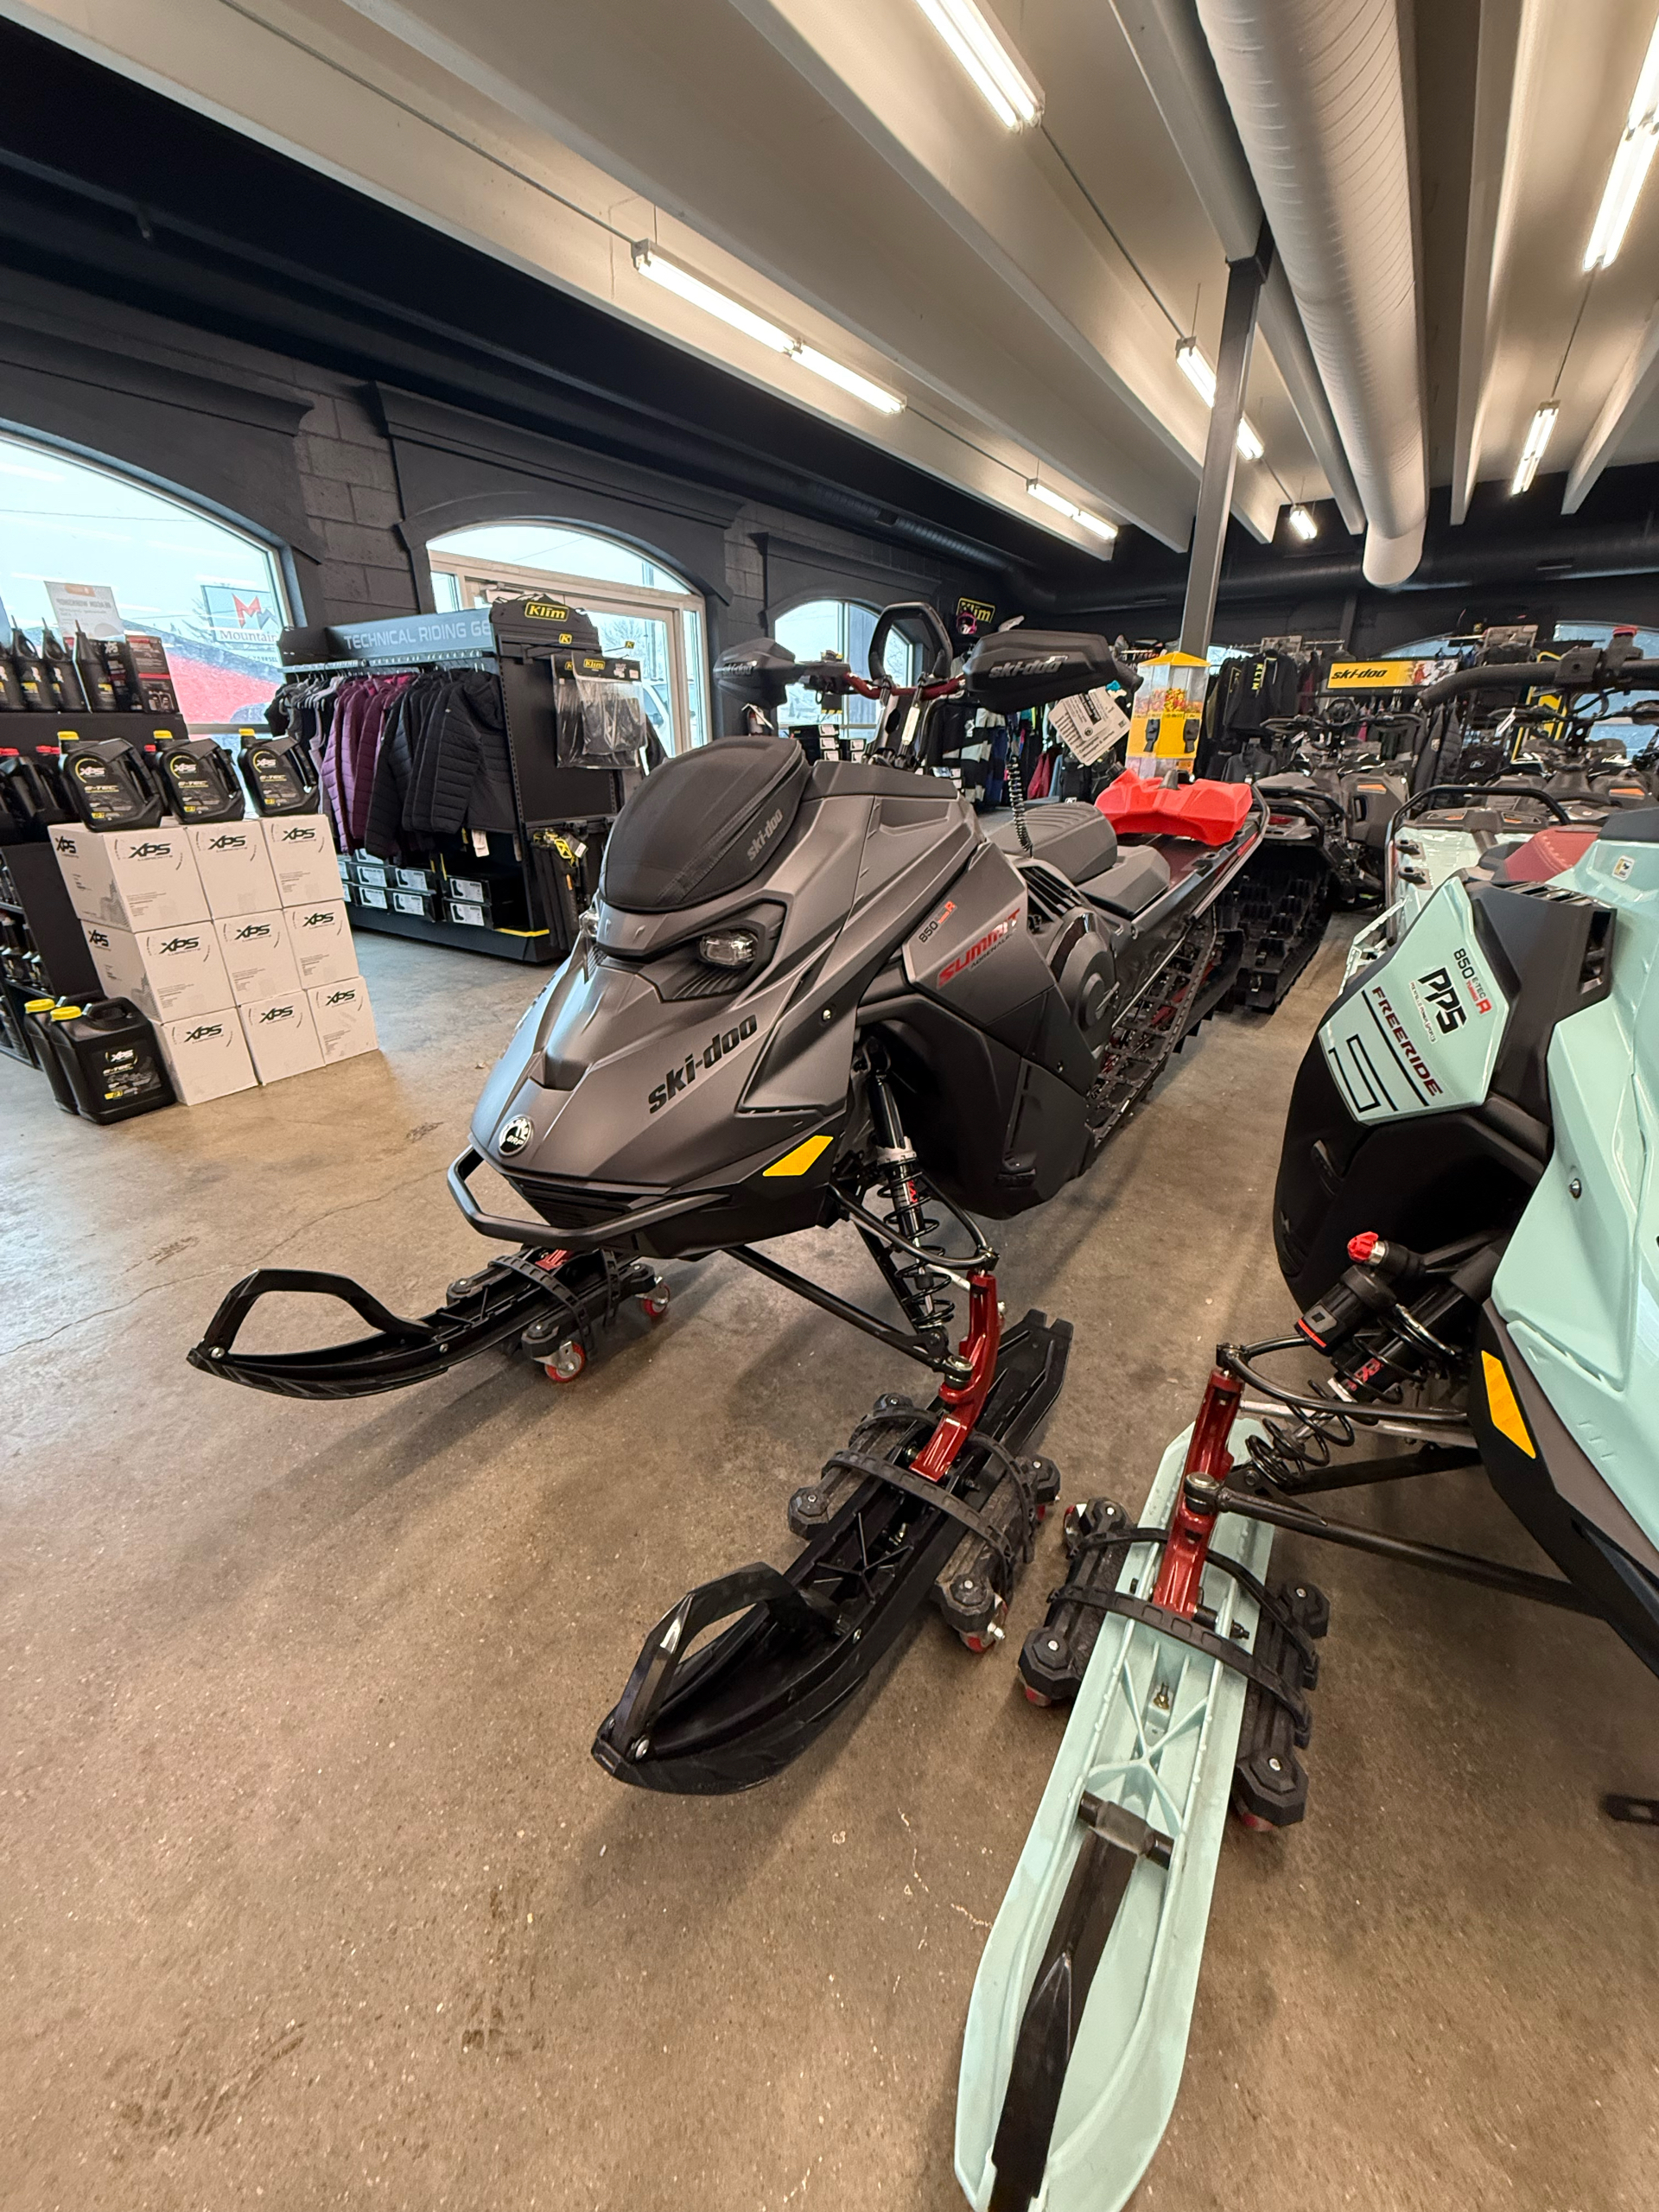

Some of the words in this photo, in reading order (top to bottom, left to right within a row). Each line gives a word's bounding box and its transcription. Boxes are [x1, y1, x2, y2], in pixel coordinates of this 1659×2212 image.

[529, 605, 566, 619] Klim
[344, 629, 416, 650] TECHNICAL
[419, 622, 467, 642] RIDING
[722, 662, 753, 676] ski-doo
[988, 659, 1063, 678] ski-doo
[1331, 668, 1389, 680] ski-doo
[79, 766, 105, 776] XPS
[174, 763, 197, 772] XPS
[257, 758, 276, 767] XPS
[207, 835, 246, 850] XPS
[282, 827, 316, 842] XPS
[747, 808, 784, 861] ski-doo
[55, 836, 77, 854] XPS
[129, 842, 172, 859] XPS
[302, 912, 334, 927] XPS
[88, 930, 110, 947] XPS
[234, 924, 271, 940] XPS
[918, 920, 938, 944] 850
[159, 937, 200, 954] XPS
[938, 907, 1020, 988] SUMMIT
[1453, 948, 1475, 980] 850
[326, 989, 356, 1006] XPS
[1417, 967, 1467, 1034] PPS
[1476, 998, 1492, 1014] R
[259, 1005, 294, 1023] XPS
[184, 1024, 223, 1043] XPS
[1371, 986, 1444, 1096] FREERIDE
[111, 1049, 134, 1062] XPS
[648, 1014, 758, 1114] ski-doo
